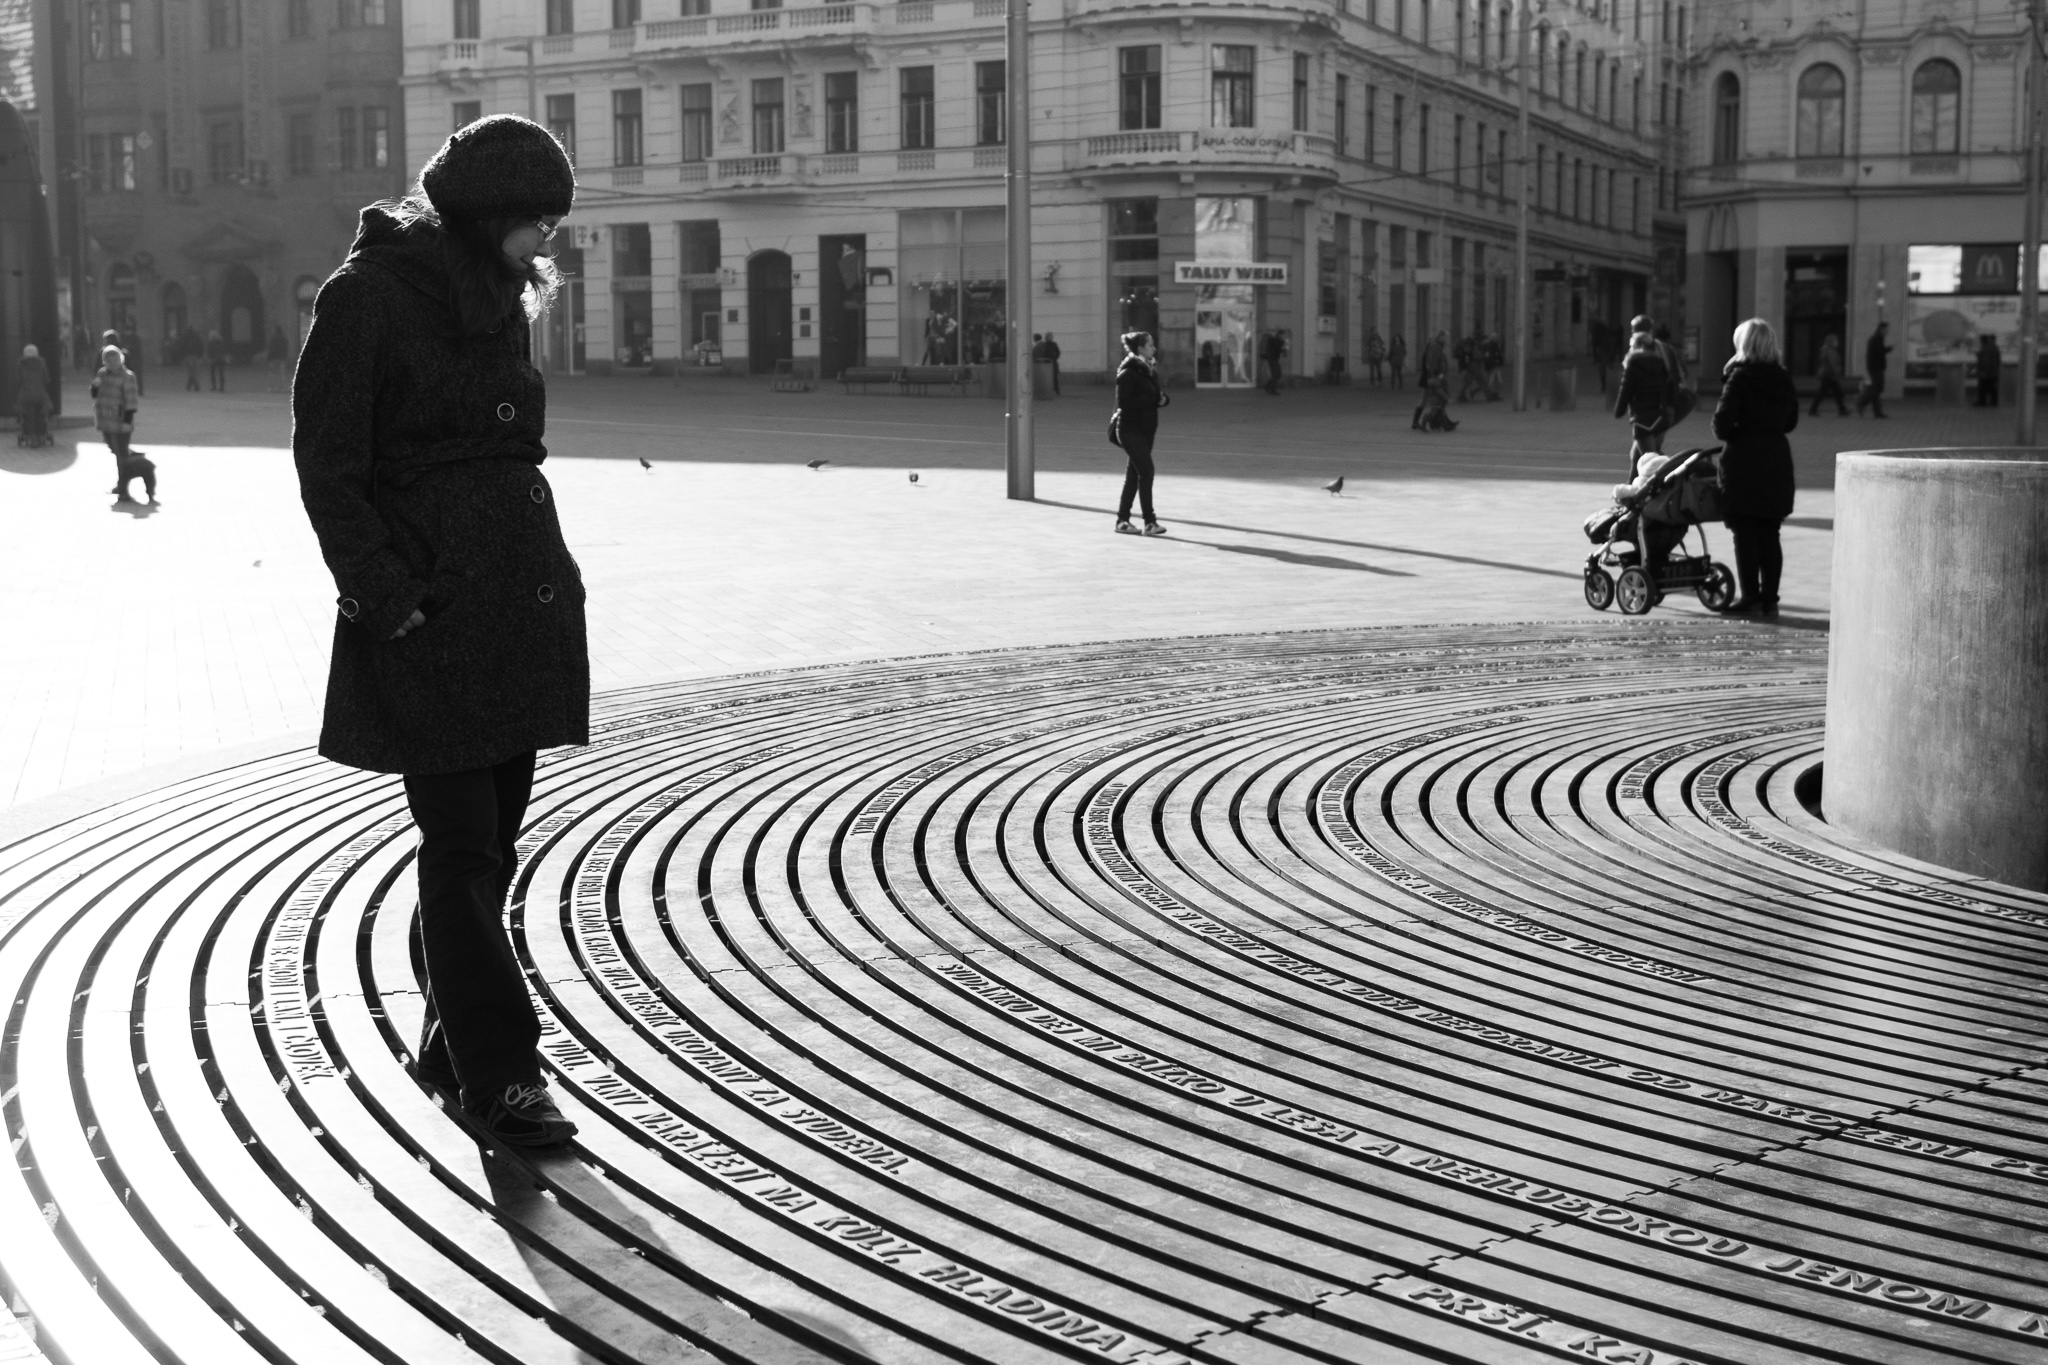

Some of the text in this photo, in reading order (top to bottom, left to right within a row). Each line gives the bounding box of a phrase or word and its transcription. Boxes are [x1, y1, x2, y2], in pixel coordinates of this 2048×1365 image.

[1180, 266, 1232, 280] TALLY
[663, 1029, 764, 1083] UKOVANÝ
[741, 1087, 791, 1107] ZA
[936, 962, 1040, 1013] STUDÁNKU
[1024, 1013, 1084, 1036] DEJ
[1071, 1033, 1123, 1052] MI
[1111, 1049, 1226, 1094] BLÍZKO
[1228, 1095, 1267, 1107] U
[1260, 1107, 1358, 1142] LESA
[1360, 1140, 1400, 1157] A
[1408, 1153, 1750, 1258] NEHLUBOKOU
[1764, 1257, 1992, 1320] JENOM
[1415, 1010, 1621, 1070] NEPORANIT
[1627, 1070, 1692, 1089] OD
[1700, 1089, 1977, 1160] NAROZENÍ
[755, 1183, 818, 1214] NA
[919, 1263, 1126, 1352] HLADINA
